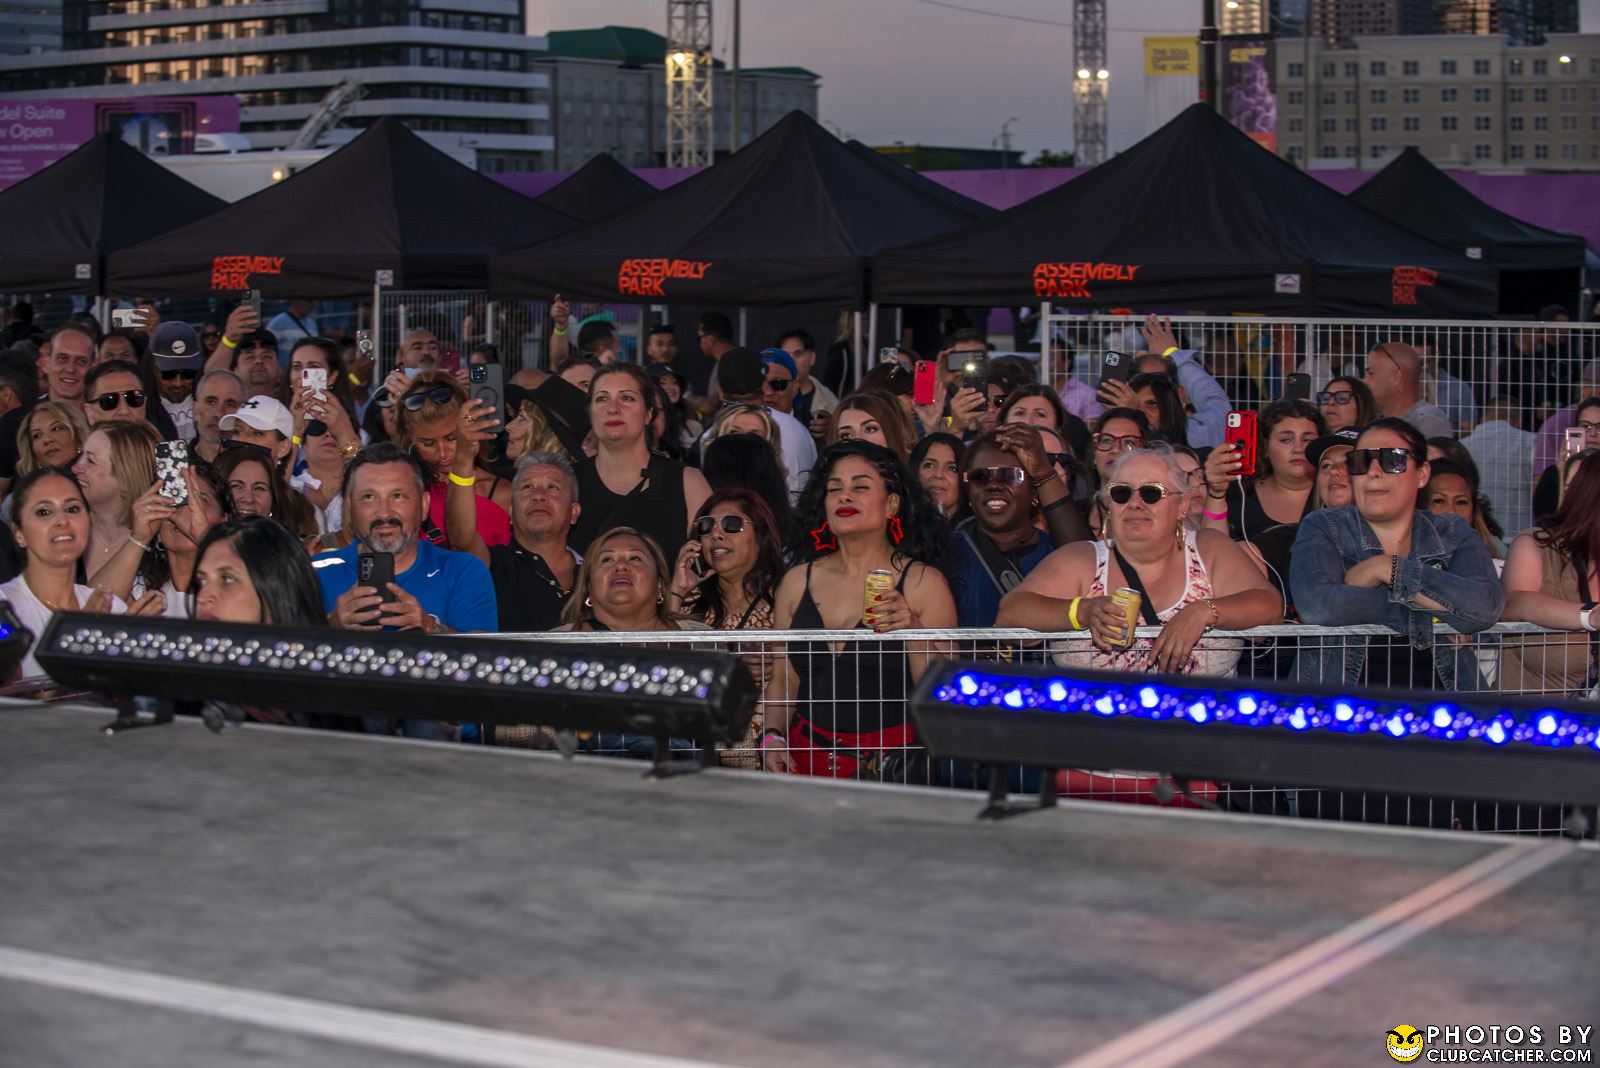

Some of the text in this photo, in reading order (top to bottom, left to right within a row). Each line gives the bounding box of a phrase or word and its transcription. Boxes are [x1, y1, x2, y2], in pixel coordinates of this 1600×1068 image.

[24, 105, 66, 120] Suite
[10, 123, 54, 141] Open
[211, 255, 285, 274] ASSEMBLY
[618, 258, 713, 278] ASSEMBLY
[1033, 262, 1142, 281] ASSEMBLY
[210, 272, 250, 290] PARK
[618, 276, 667, 296] PARK
[1034, 278, 1092, 298] PARK
